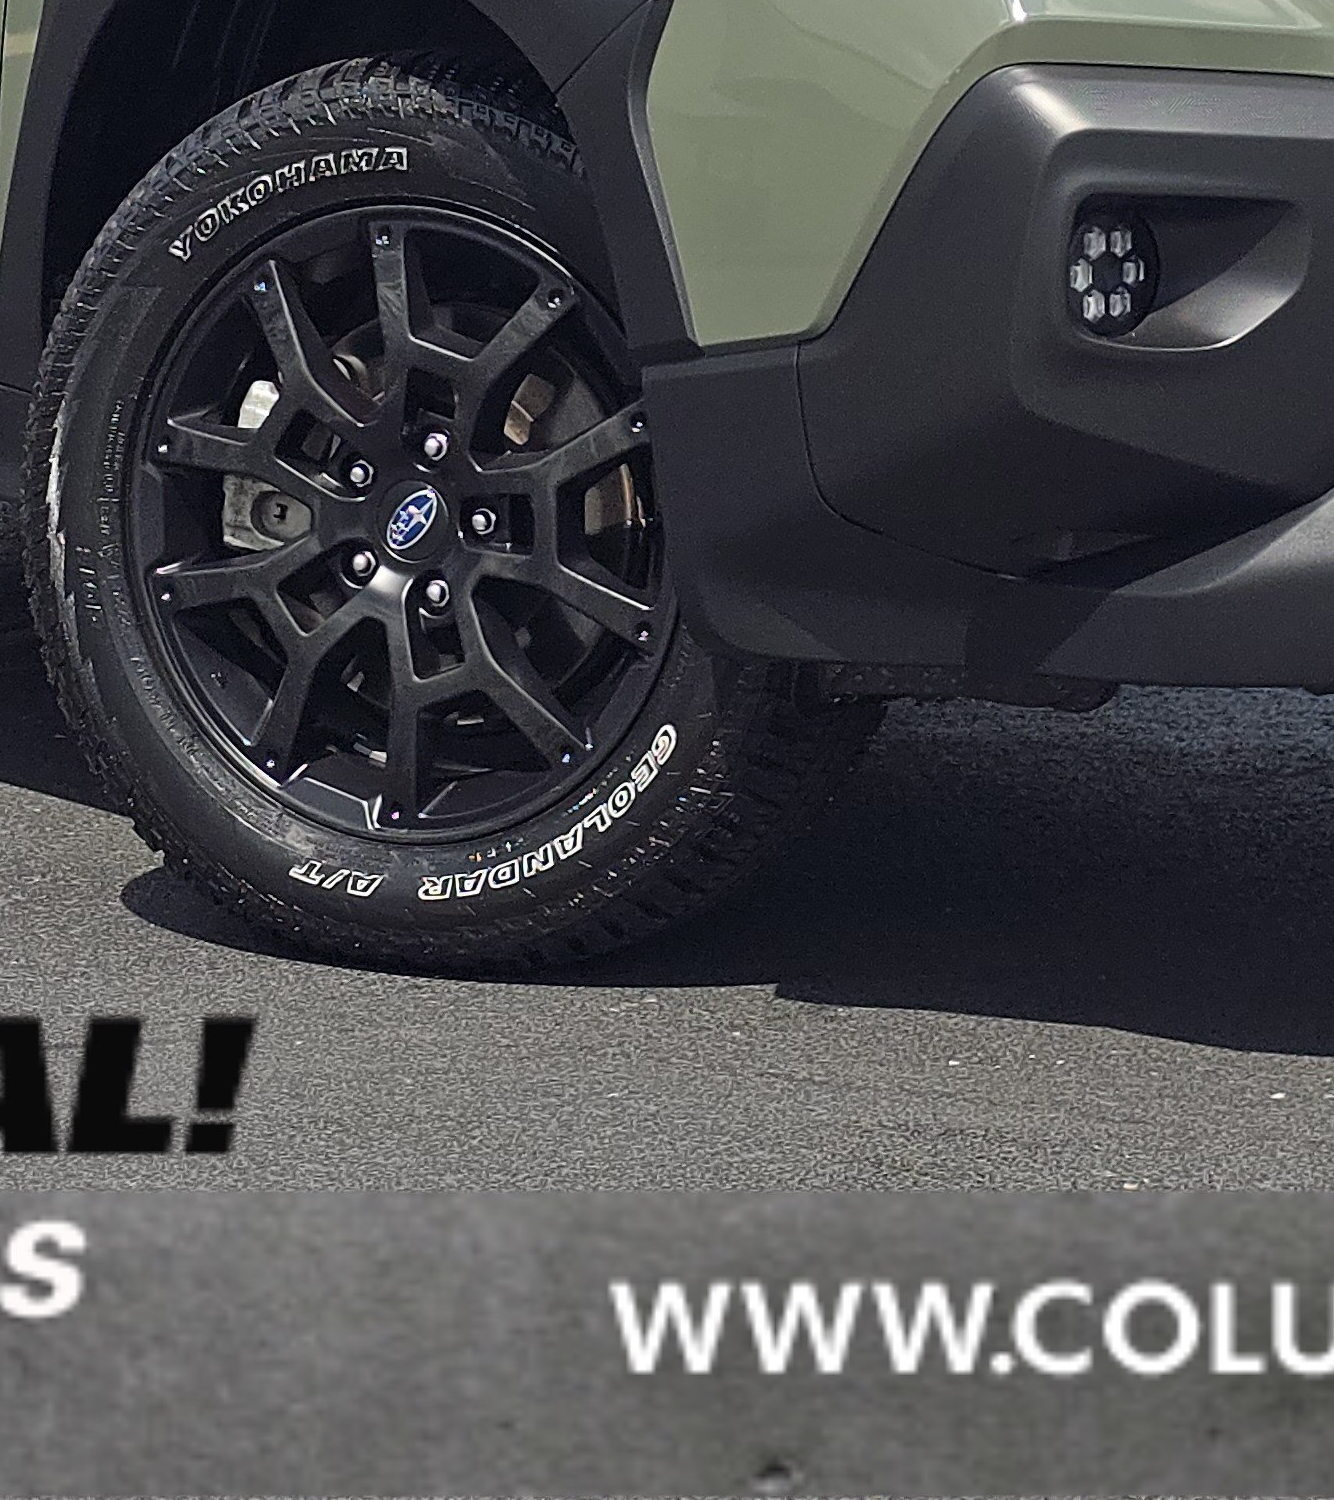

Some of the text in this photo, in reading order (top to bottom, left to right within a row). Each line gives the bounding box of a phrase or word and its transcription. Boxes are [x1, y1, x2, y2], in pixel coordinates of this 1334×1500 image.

[168, 147, 408, 262] YOKOHAMA
[418, 724, 678, 900] GEOLANDAR
[288, 860, 385, 897] A/T
